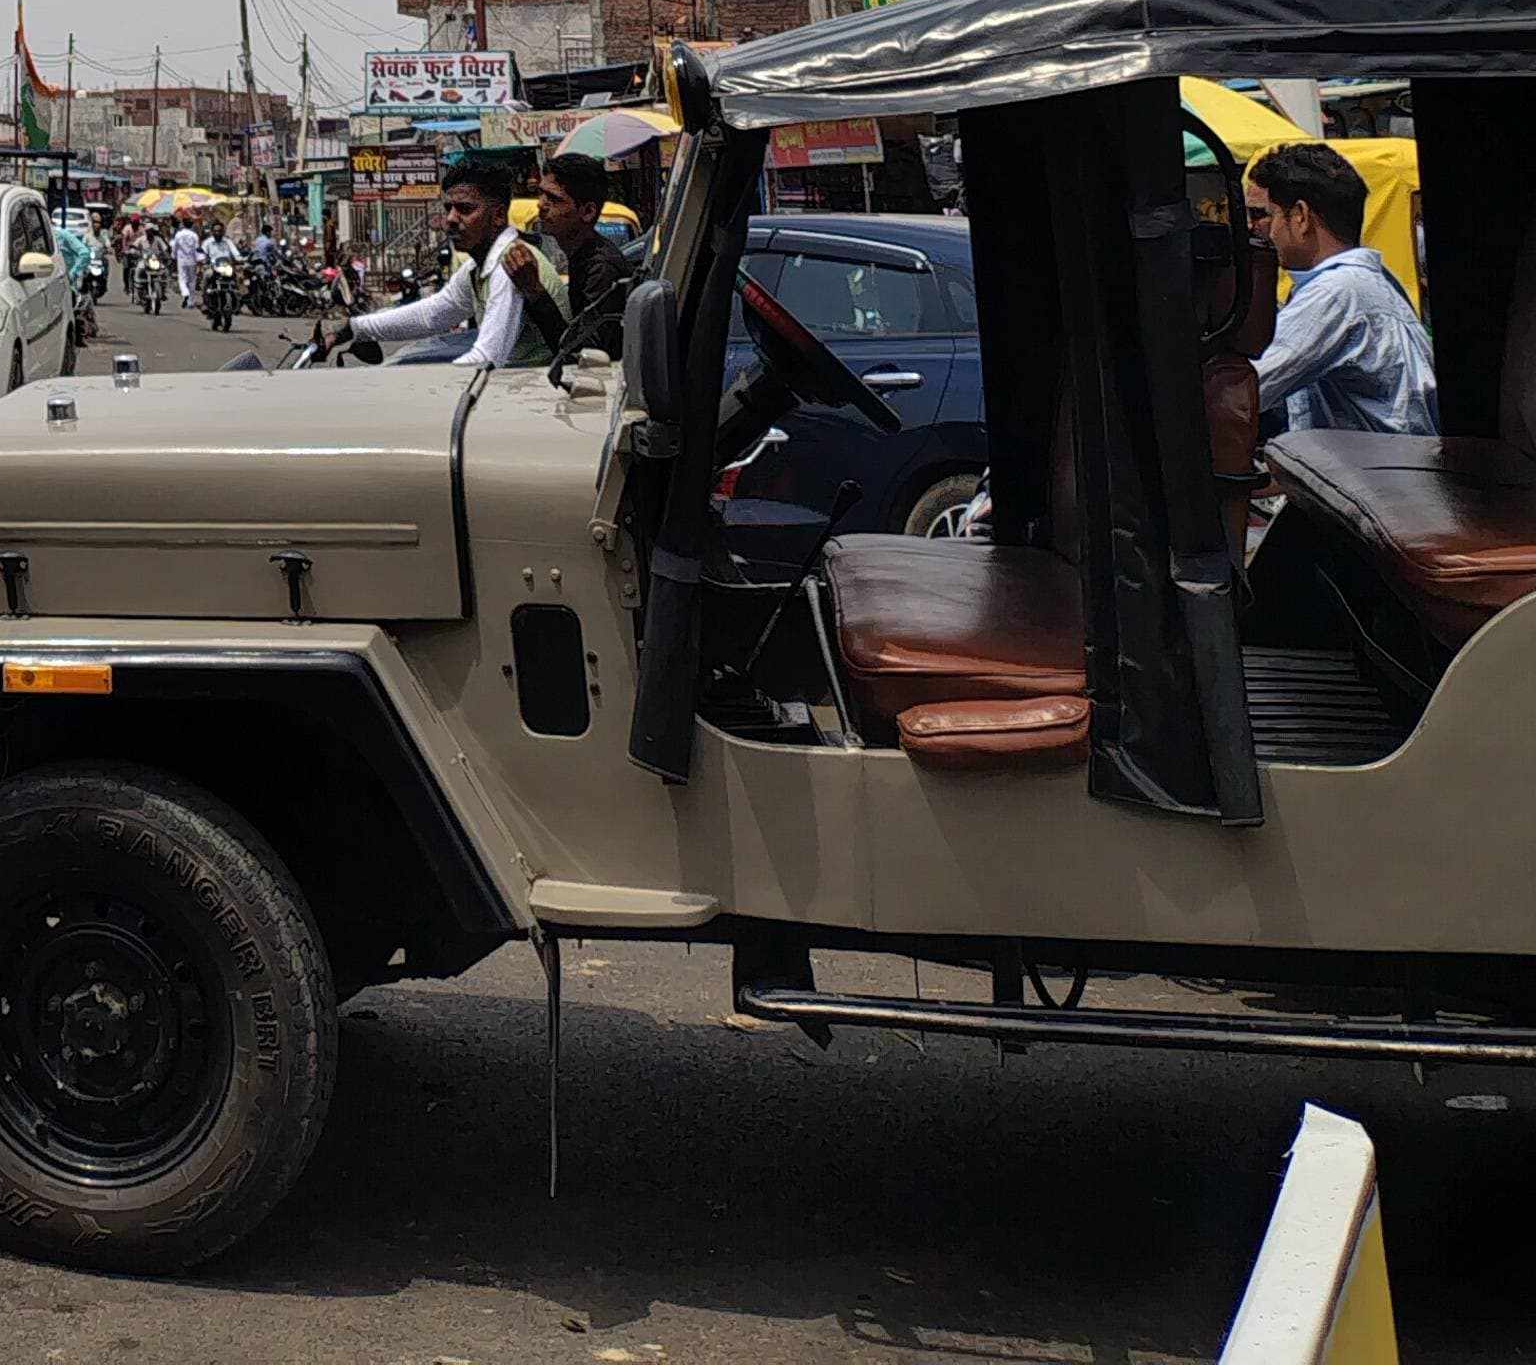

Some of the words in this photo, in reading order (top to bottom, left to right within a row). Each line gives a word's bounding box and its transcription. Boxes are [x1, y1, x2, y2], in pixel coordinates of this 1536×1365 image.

[370, 56, 418, 78] सेवक
[422, 60, 455, 84] फुट
[459, 55, 507, 78] वियर
[96, 814, 264, 982] RANGER
